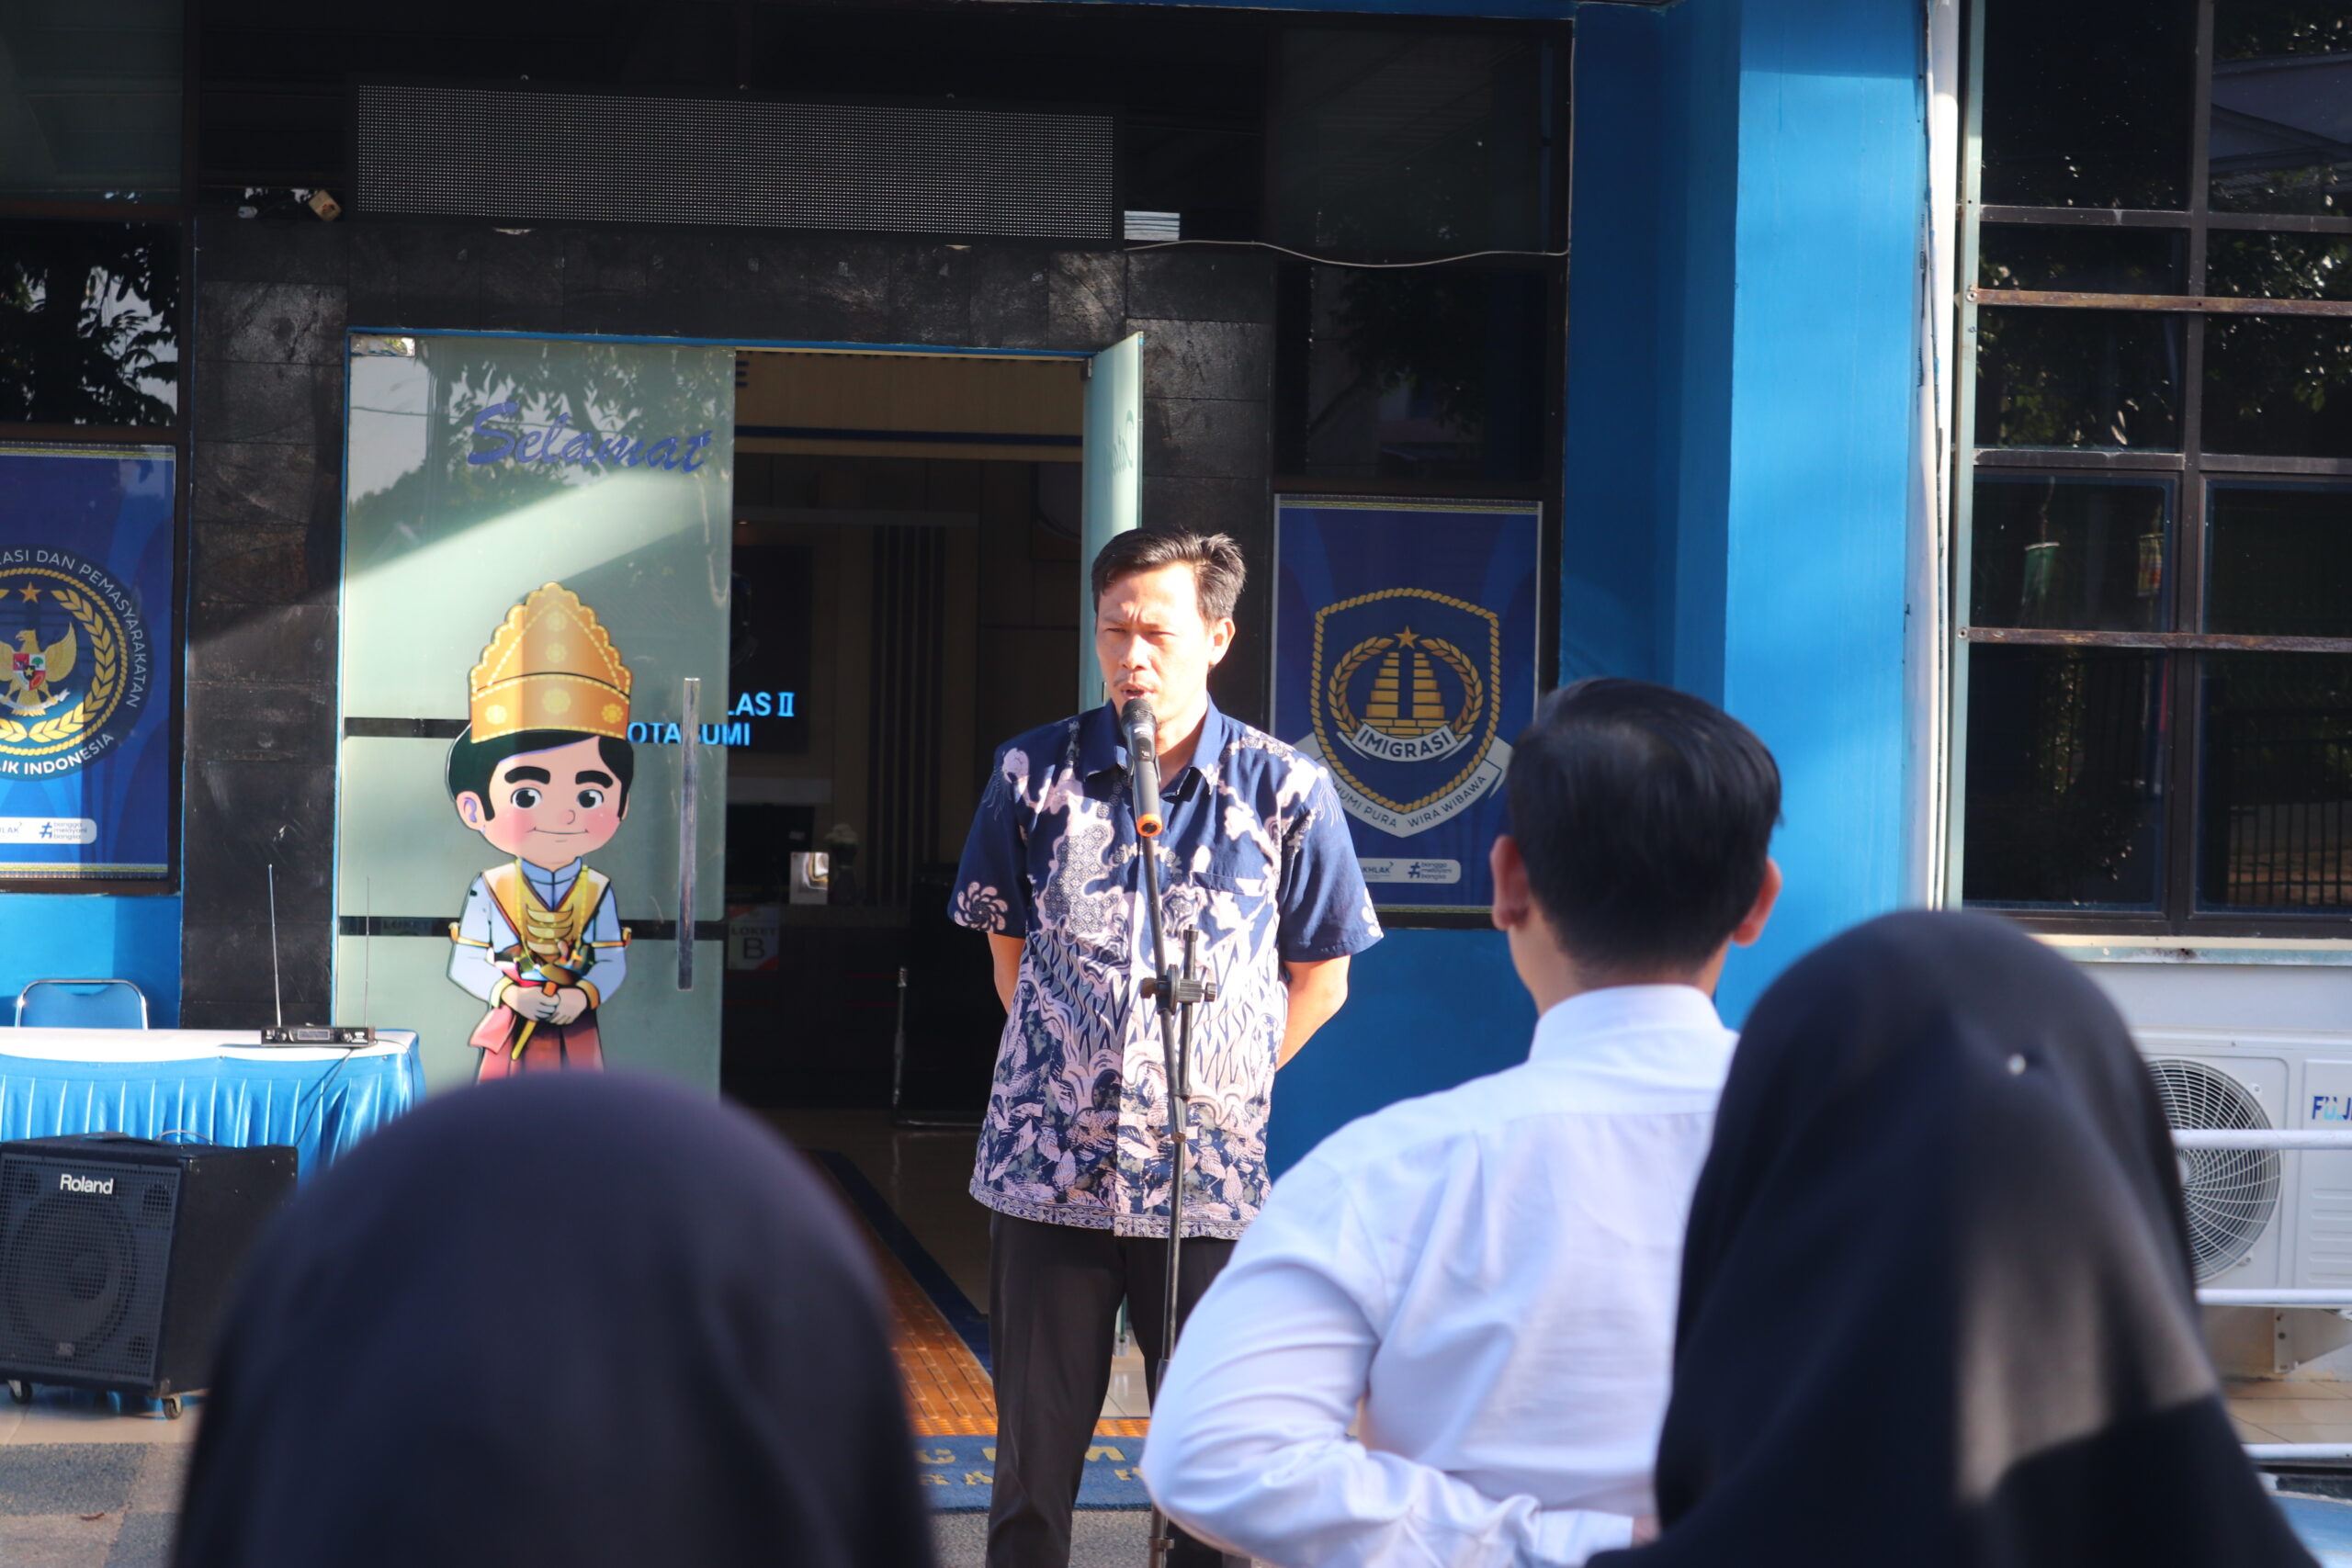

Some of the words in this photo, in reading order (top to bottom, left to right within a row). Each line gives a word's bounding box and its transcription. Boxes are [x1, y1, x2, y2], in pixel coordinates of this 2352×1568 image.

[468, 401, 713, 473] Selamat
[0, 549, 28, 566] ASI
[37, 550, 75, 570] DAN
[79, 564, 146, 707] PEMASYARAKATAN
[728, 692, 772, 716] AS
[627, 721, 751, 746] OTAUMI
[1358, 729, 1452, 759] IMIGRASI
[0, 760, 19, 774] IK
[24, 733, 114, 775] INDONESIA
[1332, 779, 1362, 810] HUMI
[1363, 806, 1398, 829] PURA
[1408, 809, 1442, 828] WIRA
[1441, 775, 1487, 813] WIBAWA
[1361, 866, 1391, 874] KHLAK
[743, 937, 765, 960] B
[2312, 1096, 2352, 1121] FUJ
[60, 1174, 114, 1195] Roland
